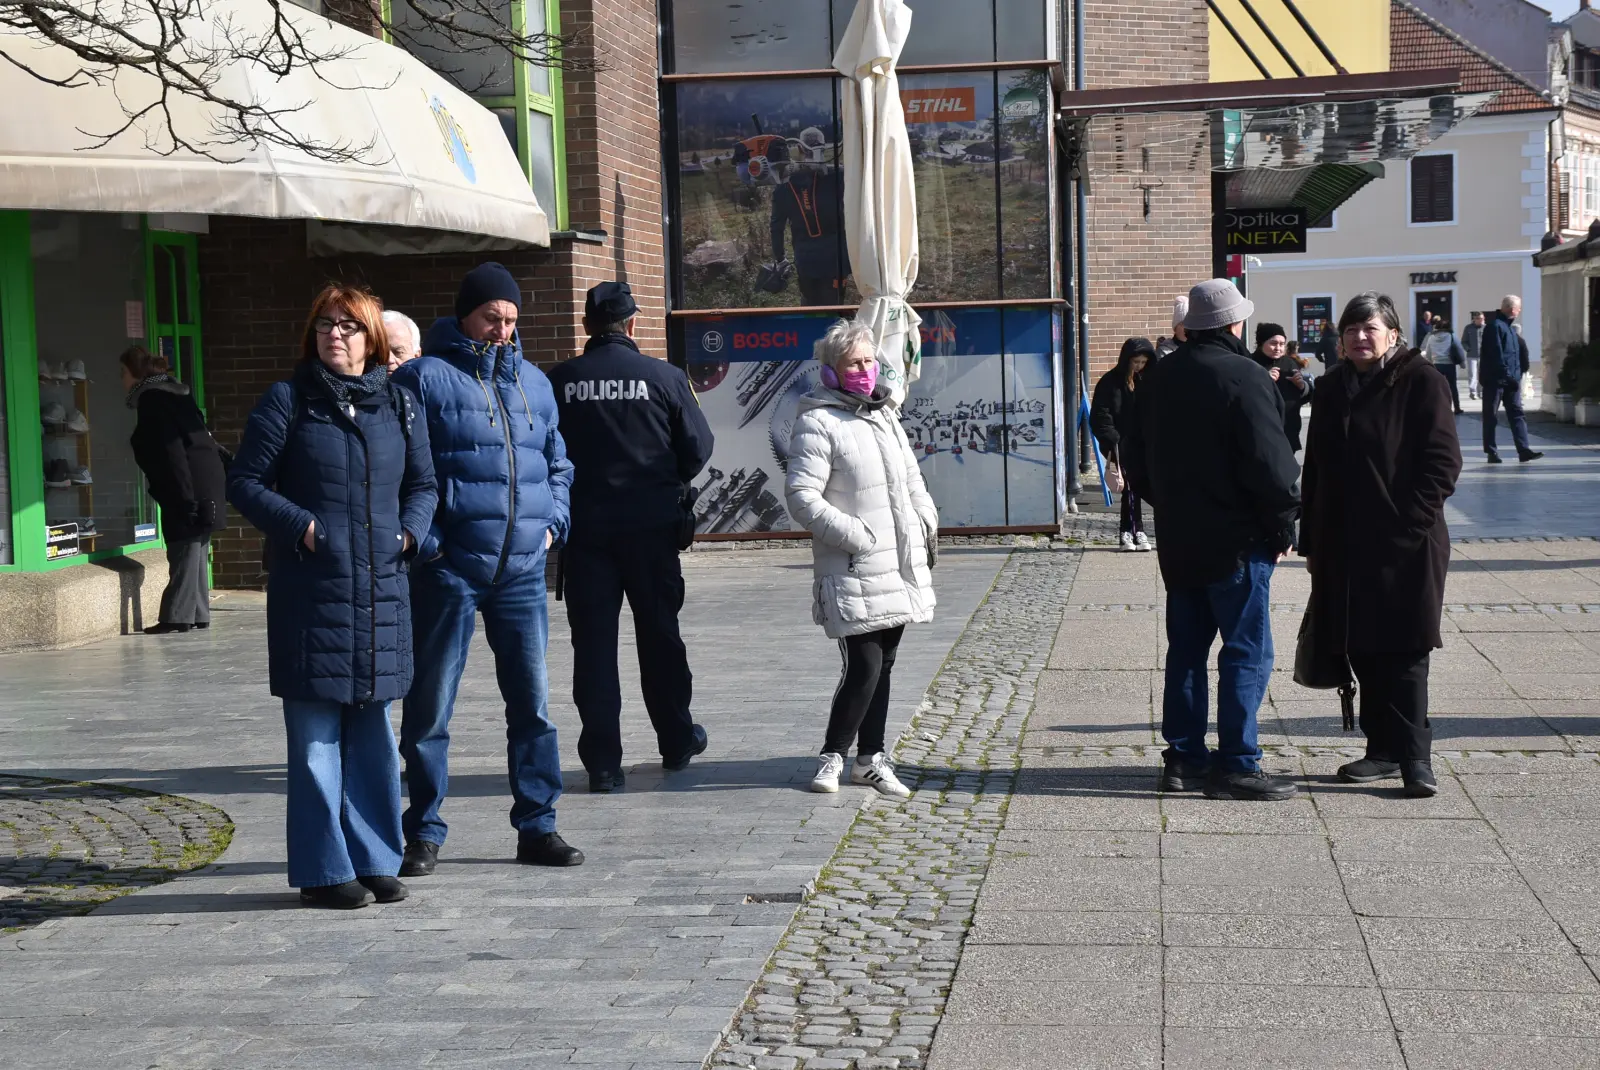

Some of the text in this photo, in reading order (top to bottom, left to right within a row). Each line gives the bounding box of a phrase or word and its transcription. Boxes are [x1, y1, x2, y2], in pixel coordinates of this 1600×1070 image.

[906, 97, 968, 114] STIHL
[1409, 271, 1459, 285] TISAK
[733, 331, 798, 349] BOSCH
[920, 327, 956, 343] SCH
[564, 379, 650, 403] POLICIJA
